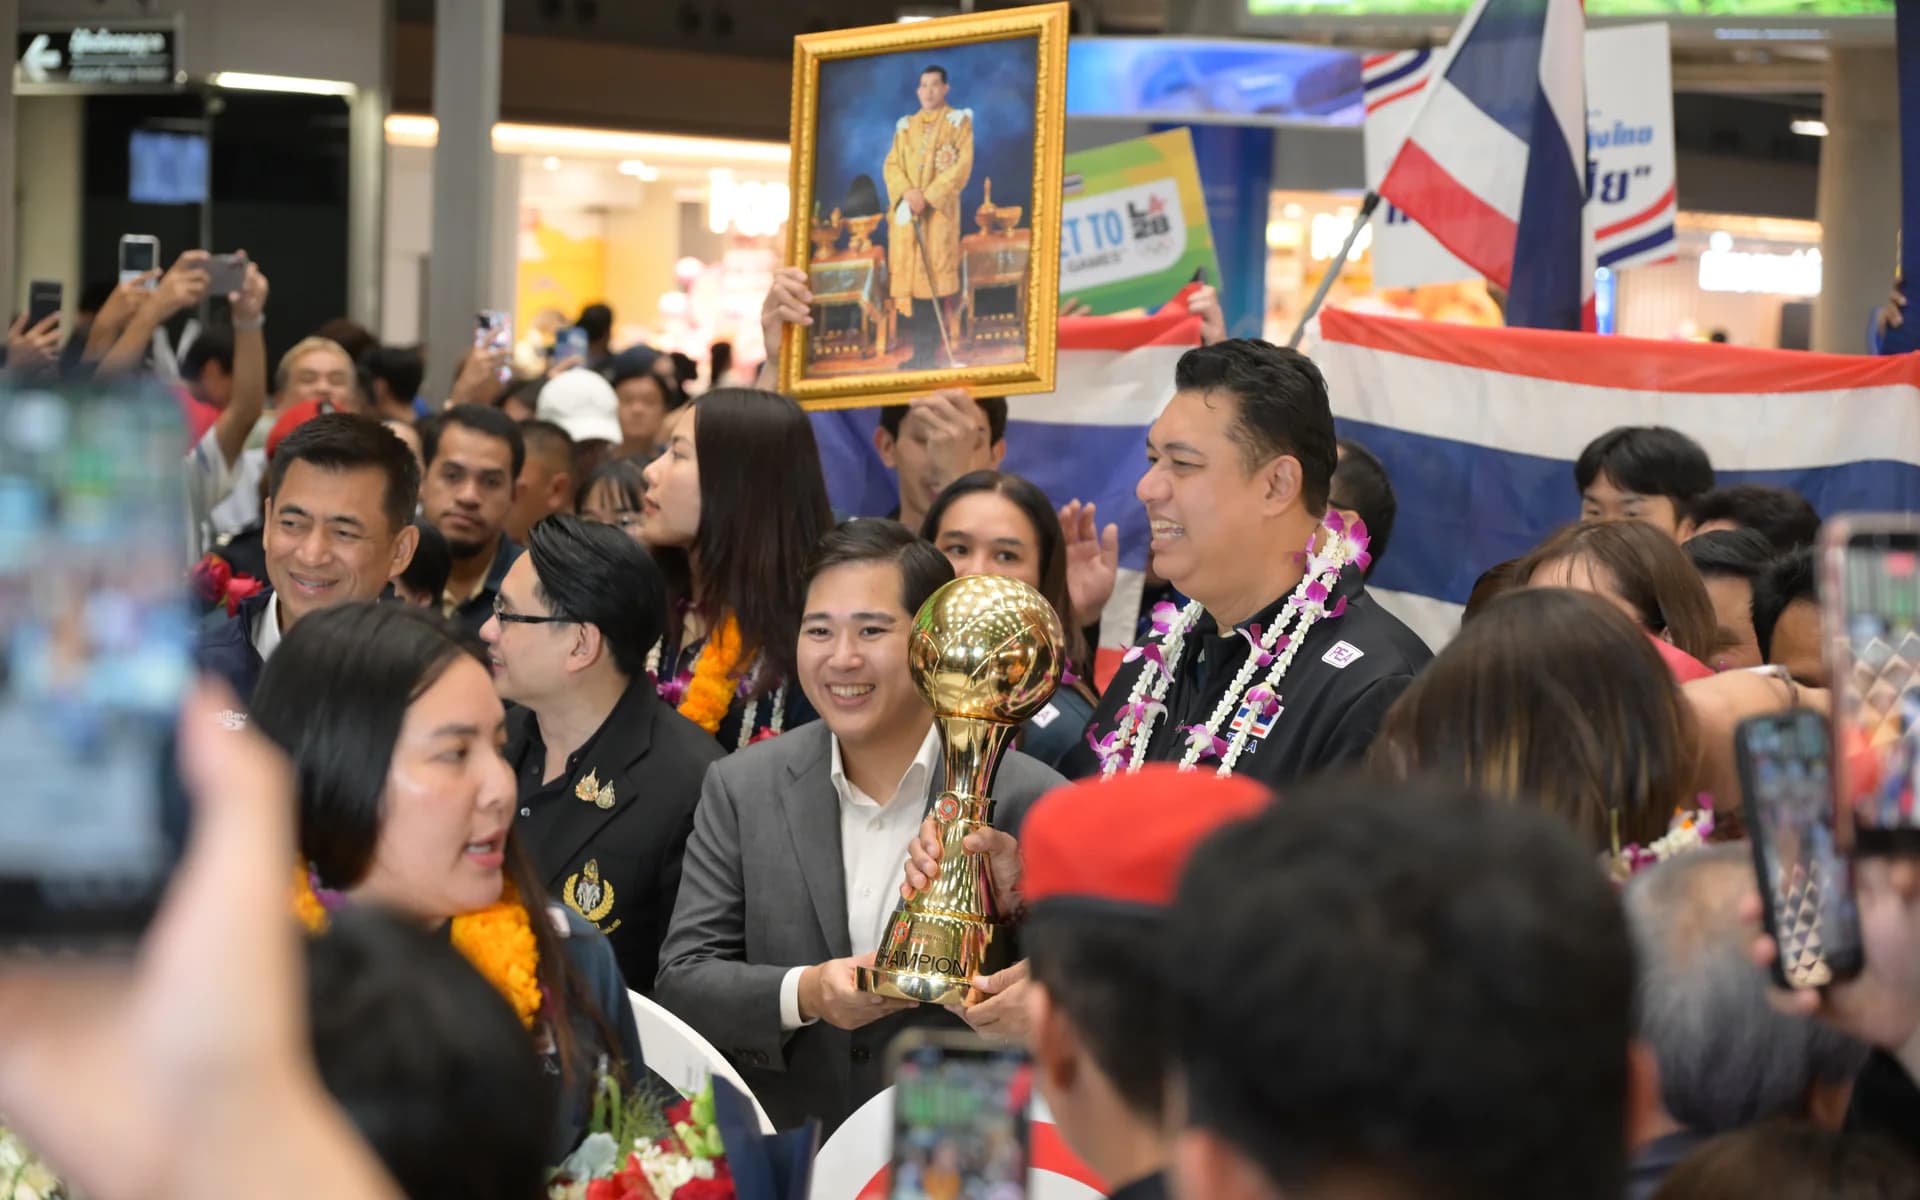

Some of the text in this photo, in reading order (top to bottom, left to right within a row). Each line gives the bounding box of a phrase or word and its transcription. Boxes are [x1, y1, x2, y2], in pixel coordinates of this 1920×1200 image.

[1086, 209, 1124, 250] TO
[1329, 646, 1354, 663] PEA
[1226, 732, 1258, 754] TA
